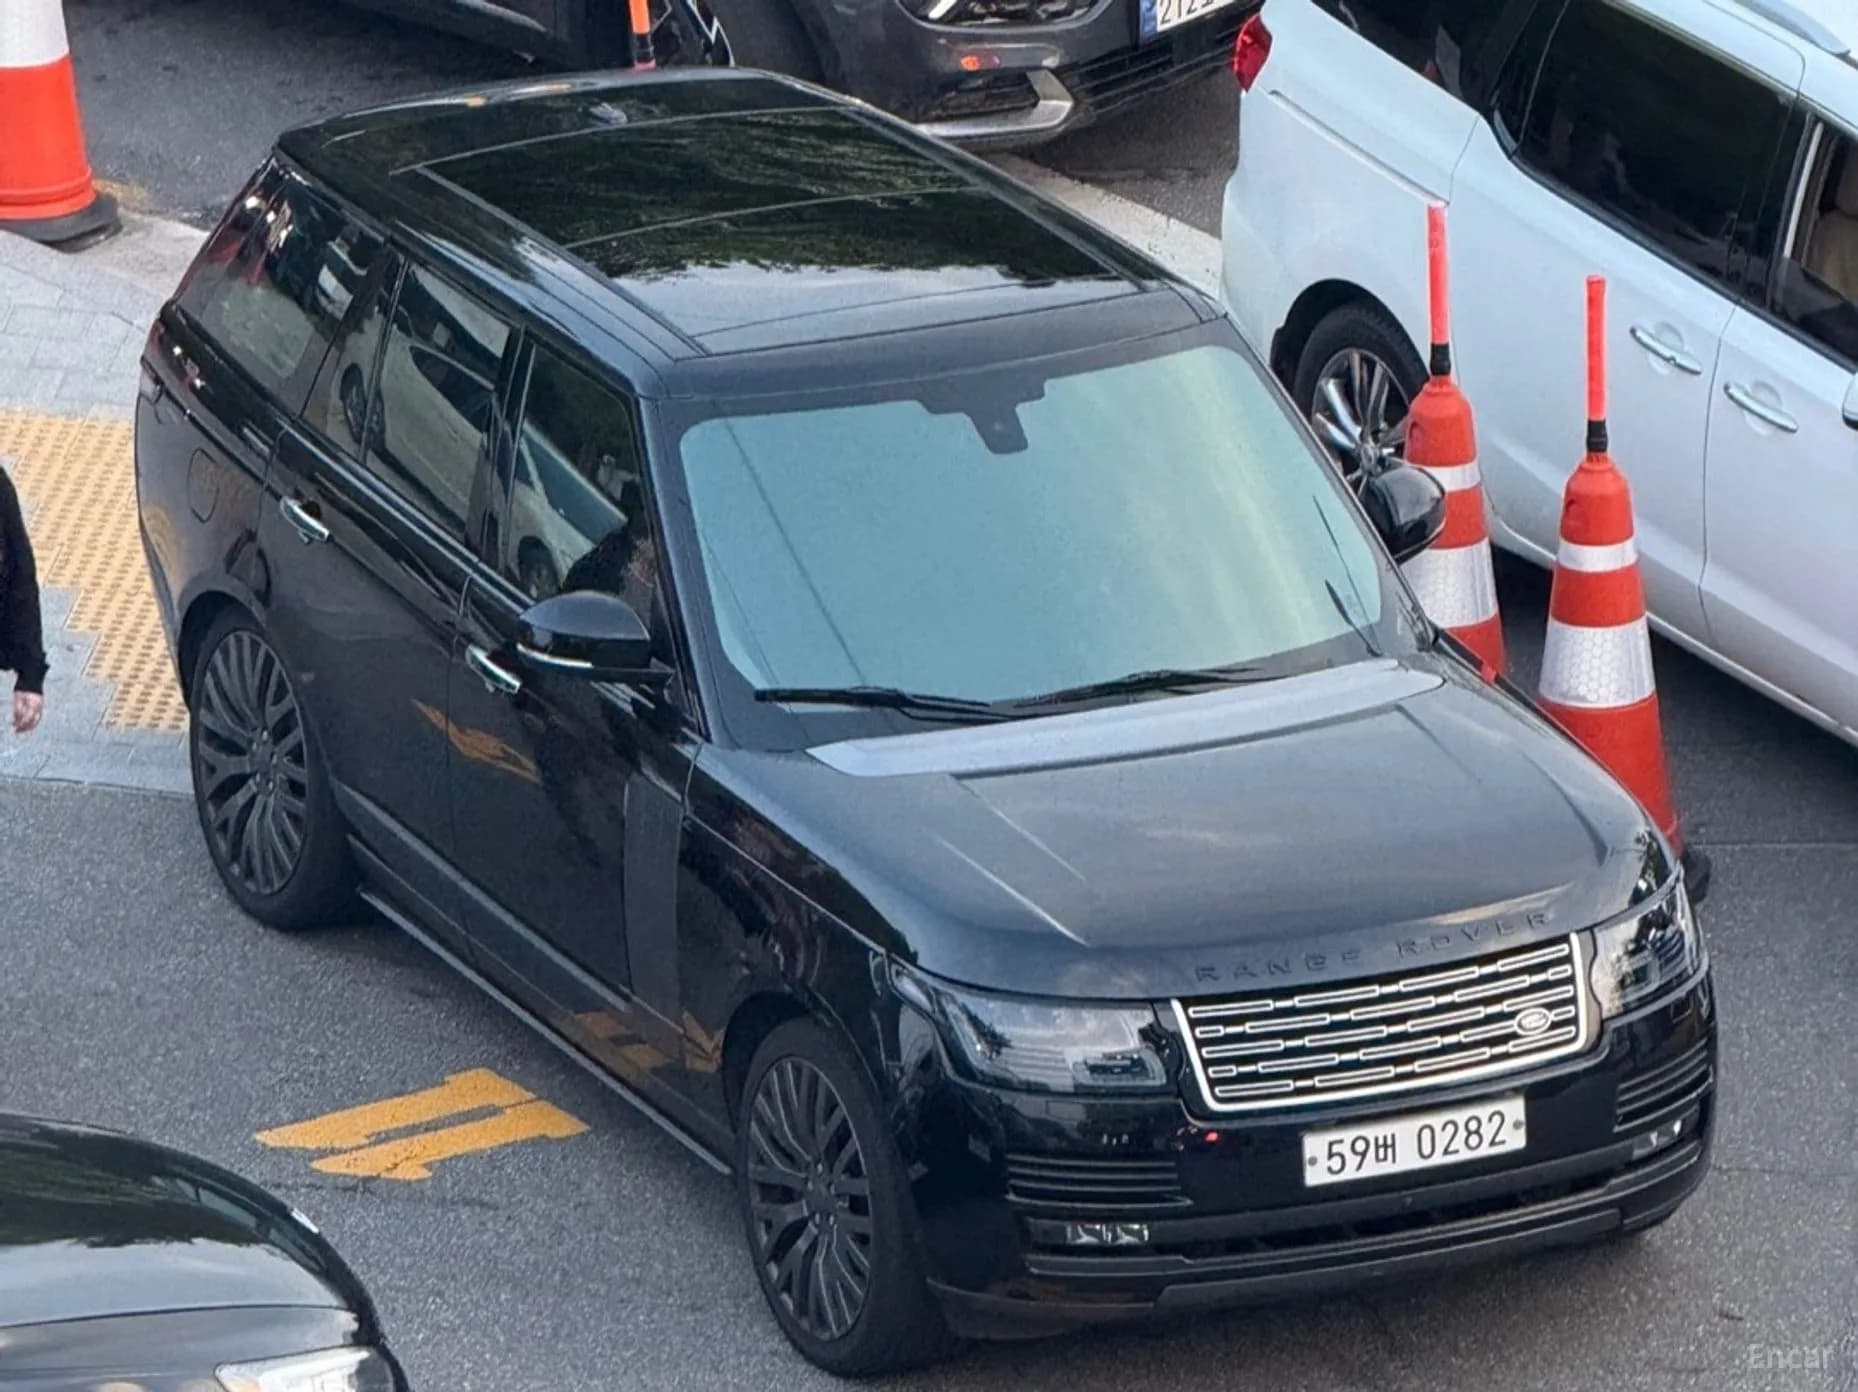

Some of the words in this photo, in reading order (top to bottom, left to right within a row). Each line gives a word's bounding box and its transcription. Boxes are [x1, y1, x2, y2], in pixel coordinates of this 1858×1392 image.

[1195, 949, 1360, 982] RANGE
[1396, 912, 1546, 958] ROVER
[1327, 1133, 1396, 1175] 59버
[1417, 1110, 1506, 1160] 0282
